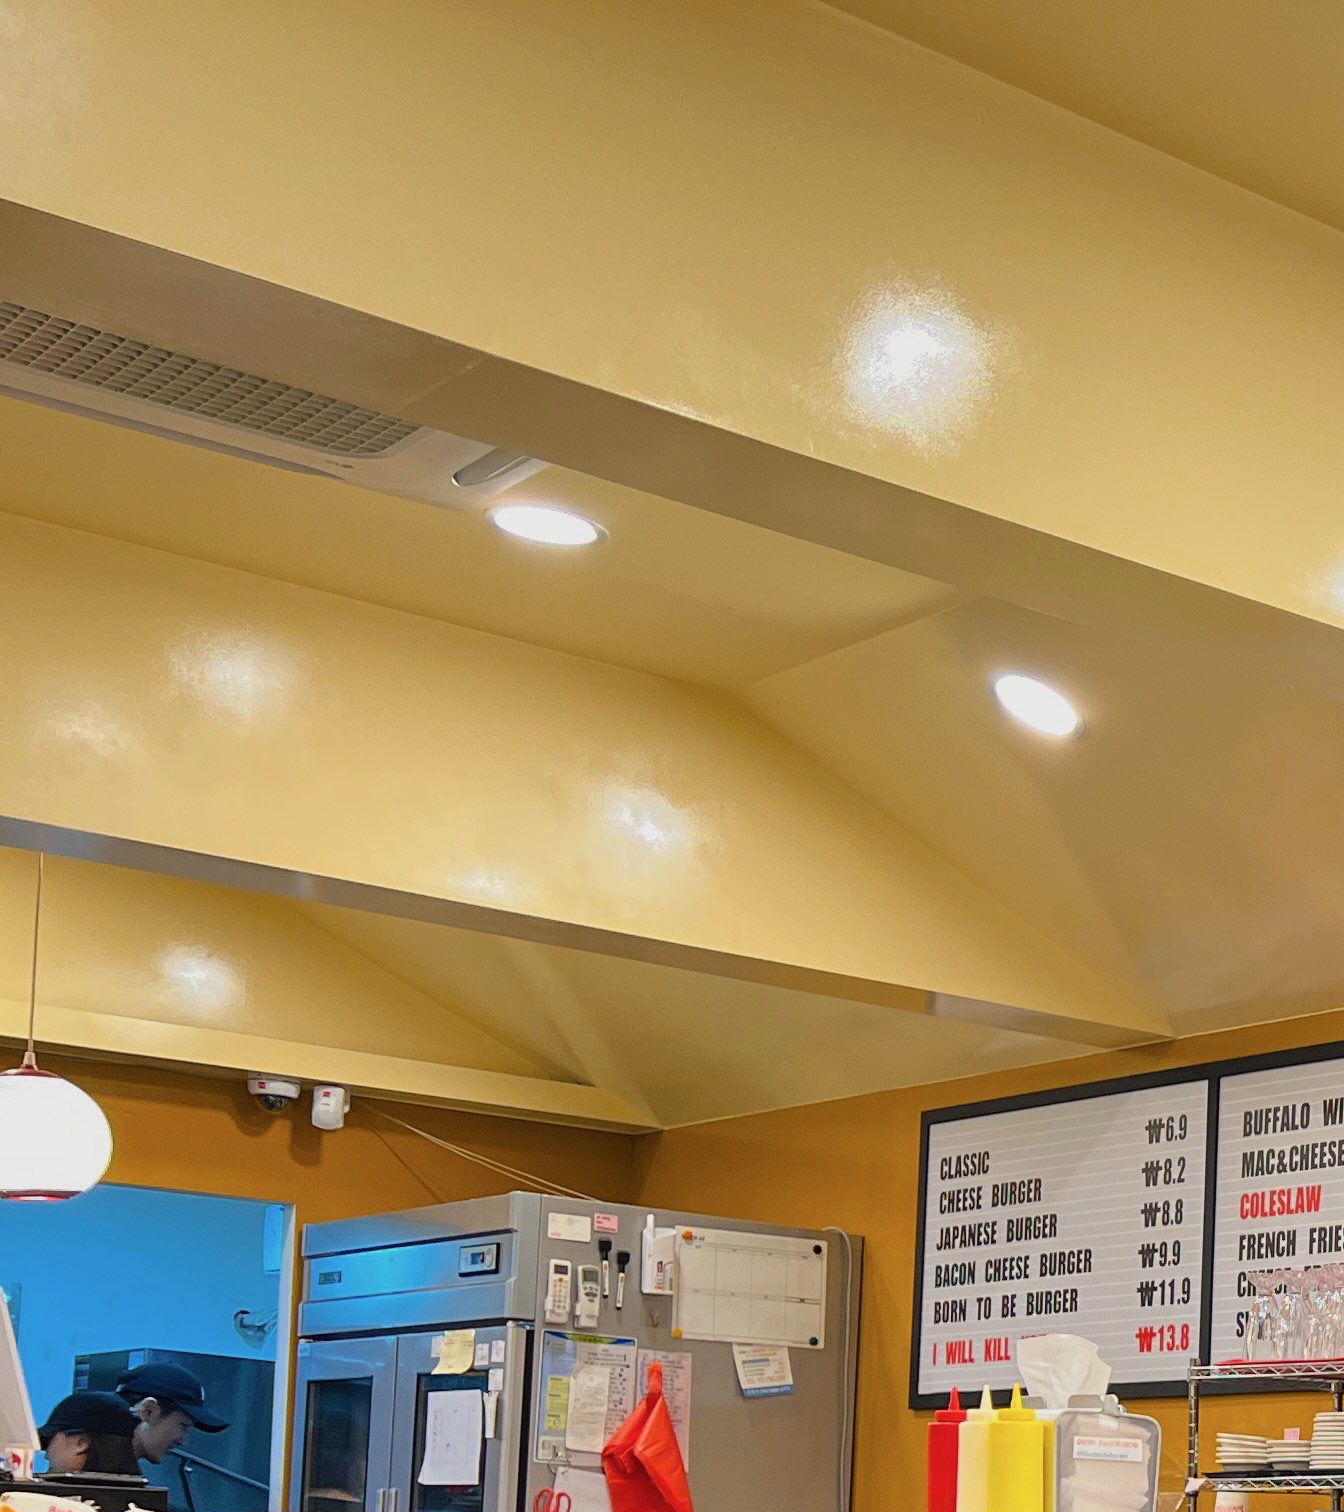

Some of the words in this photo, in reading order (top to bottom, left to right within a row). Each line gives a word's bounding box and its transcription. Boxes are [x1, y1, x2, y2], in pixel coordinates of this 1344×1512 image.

[1243, 1103, 1310, 1137] BUFFALO
[941, 1151, 989, 1180] CLASSIC
[1145, 1114, 1187, 1144] ₩6.9
[1242, 1139, 1344, 1178] MAC&CHEESE
[940, 1186, 982, 1214] CHEESE
[992, 1179, 1041, 1207] BURGER
[1142, 1157, 1185, 1187] ₩8.2
[1240, 1186, 1321, 1219] COLESLAW
[937, 1221, 996, 1250] JAPANESE
[1007, 1214, 1057, 1242] BURGER
[1141, 1199, 1183, 1227] ₩8.8
[1239, 1230, 1296, 1261] FRENCH
[935, 1262, 975, 1288] BACON
[985, 1256, 1029, 1282] CHEESE
[1040, 1249, 1091, 1277] BURGER
[1138, 1240, 1180, 1268] ₩9.9
[934, 1299, 966, 1324] BORN
[977, 1297, 991, 1320] TO
[1002, 1294, 1016, 1318] BE
[1027, 1289, 1077, 1316] BURGER
[1137, 1278, 1190, 1307] ₩11.9
[933, 1344, 938, 1365] I
[947, 1341, 974, 1364] WILL
[985, 1338, 1010, 1361] KILL
[1136, 1324, 1189, 1352] ₩13.8
